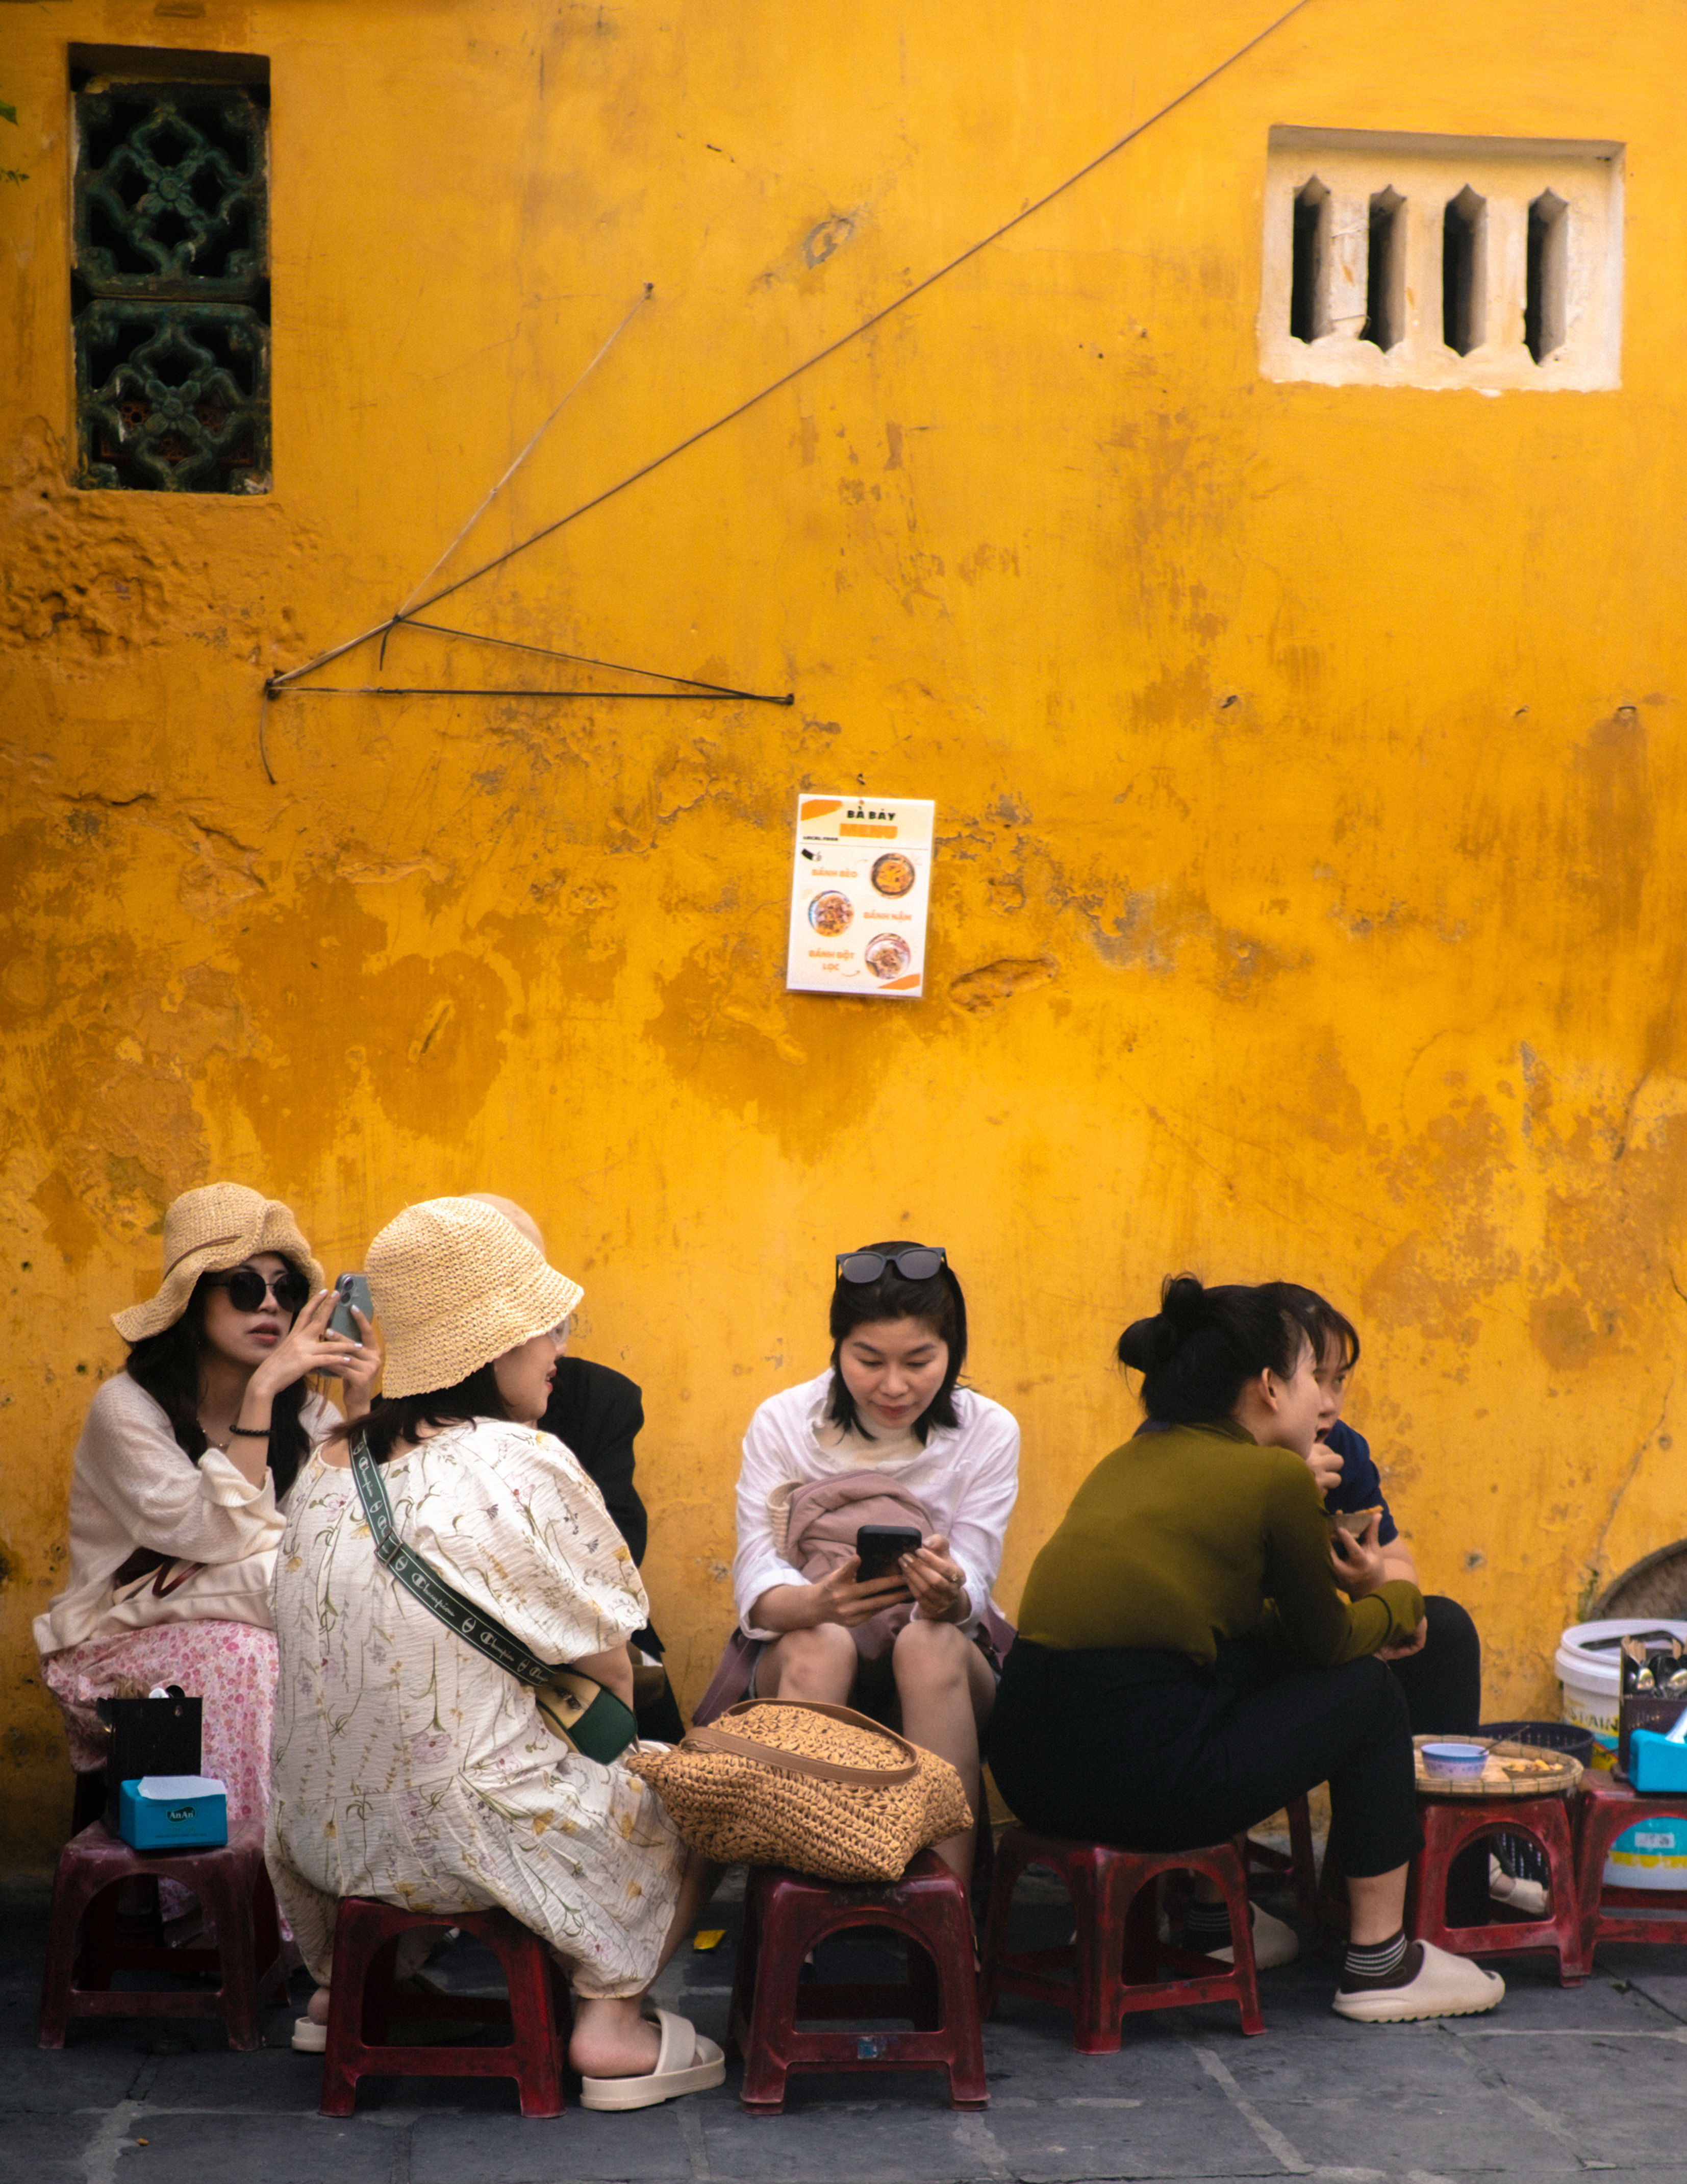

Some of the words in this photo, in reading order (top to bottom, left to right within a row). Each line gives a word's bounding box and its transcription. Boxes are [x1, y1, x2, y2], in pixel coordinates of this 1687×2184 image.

[847, 806, 865, 819] BÀ
[822, 963, 840, 973] LỌC
[359, 1456, 373, 1498] Champion
[411, 1573, 455, 1617] Champion
[480, 1632, 514, 1661] Champion
[169, 1811, 194, 1819] AnAn
